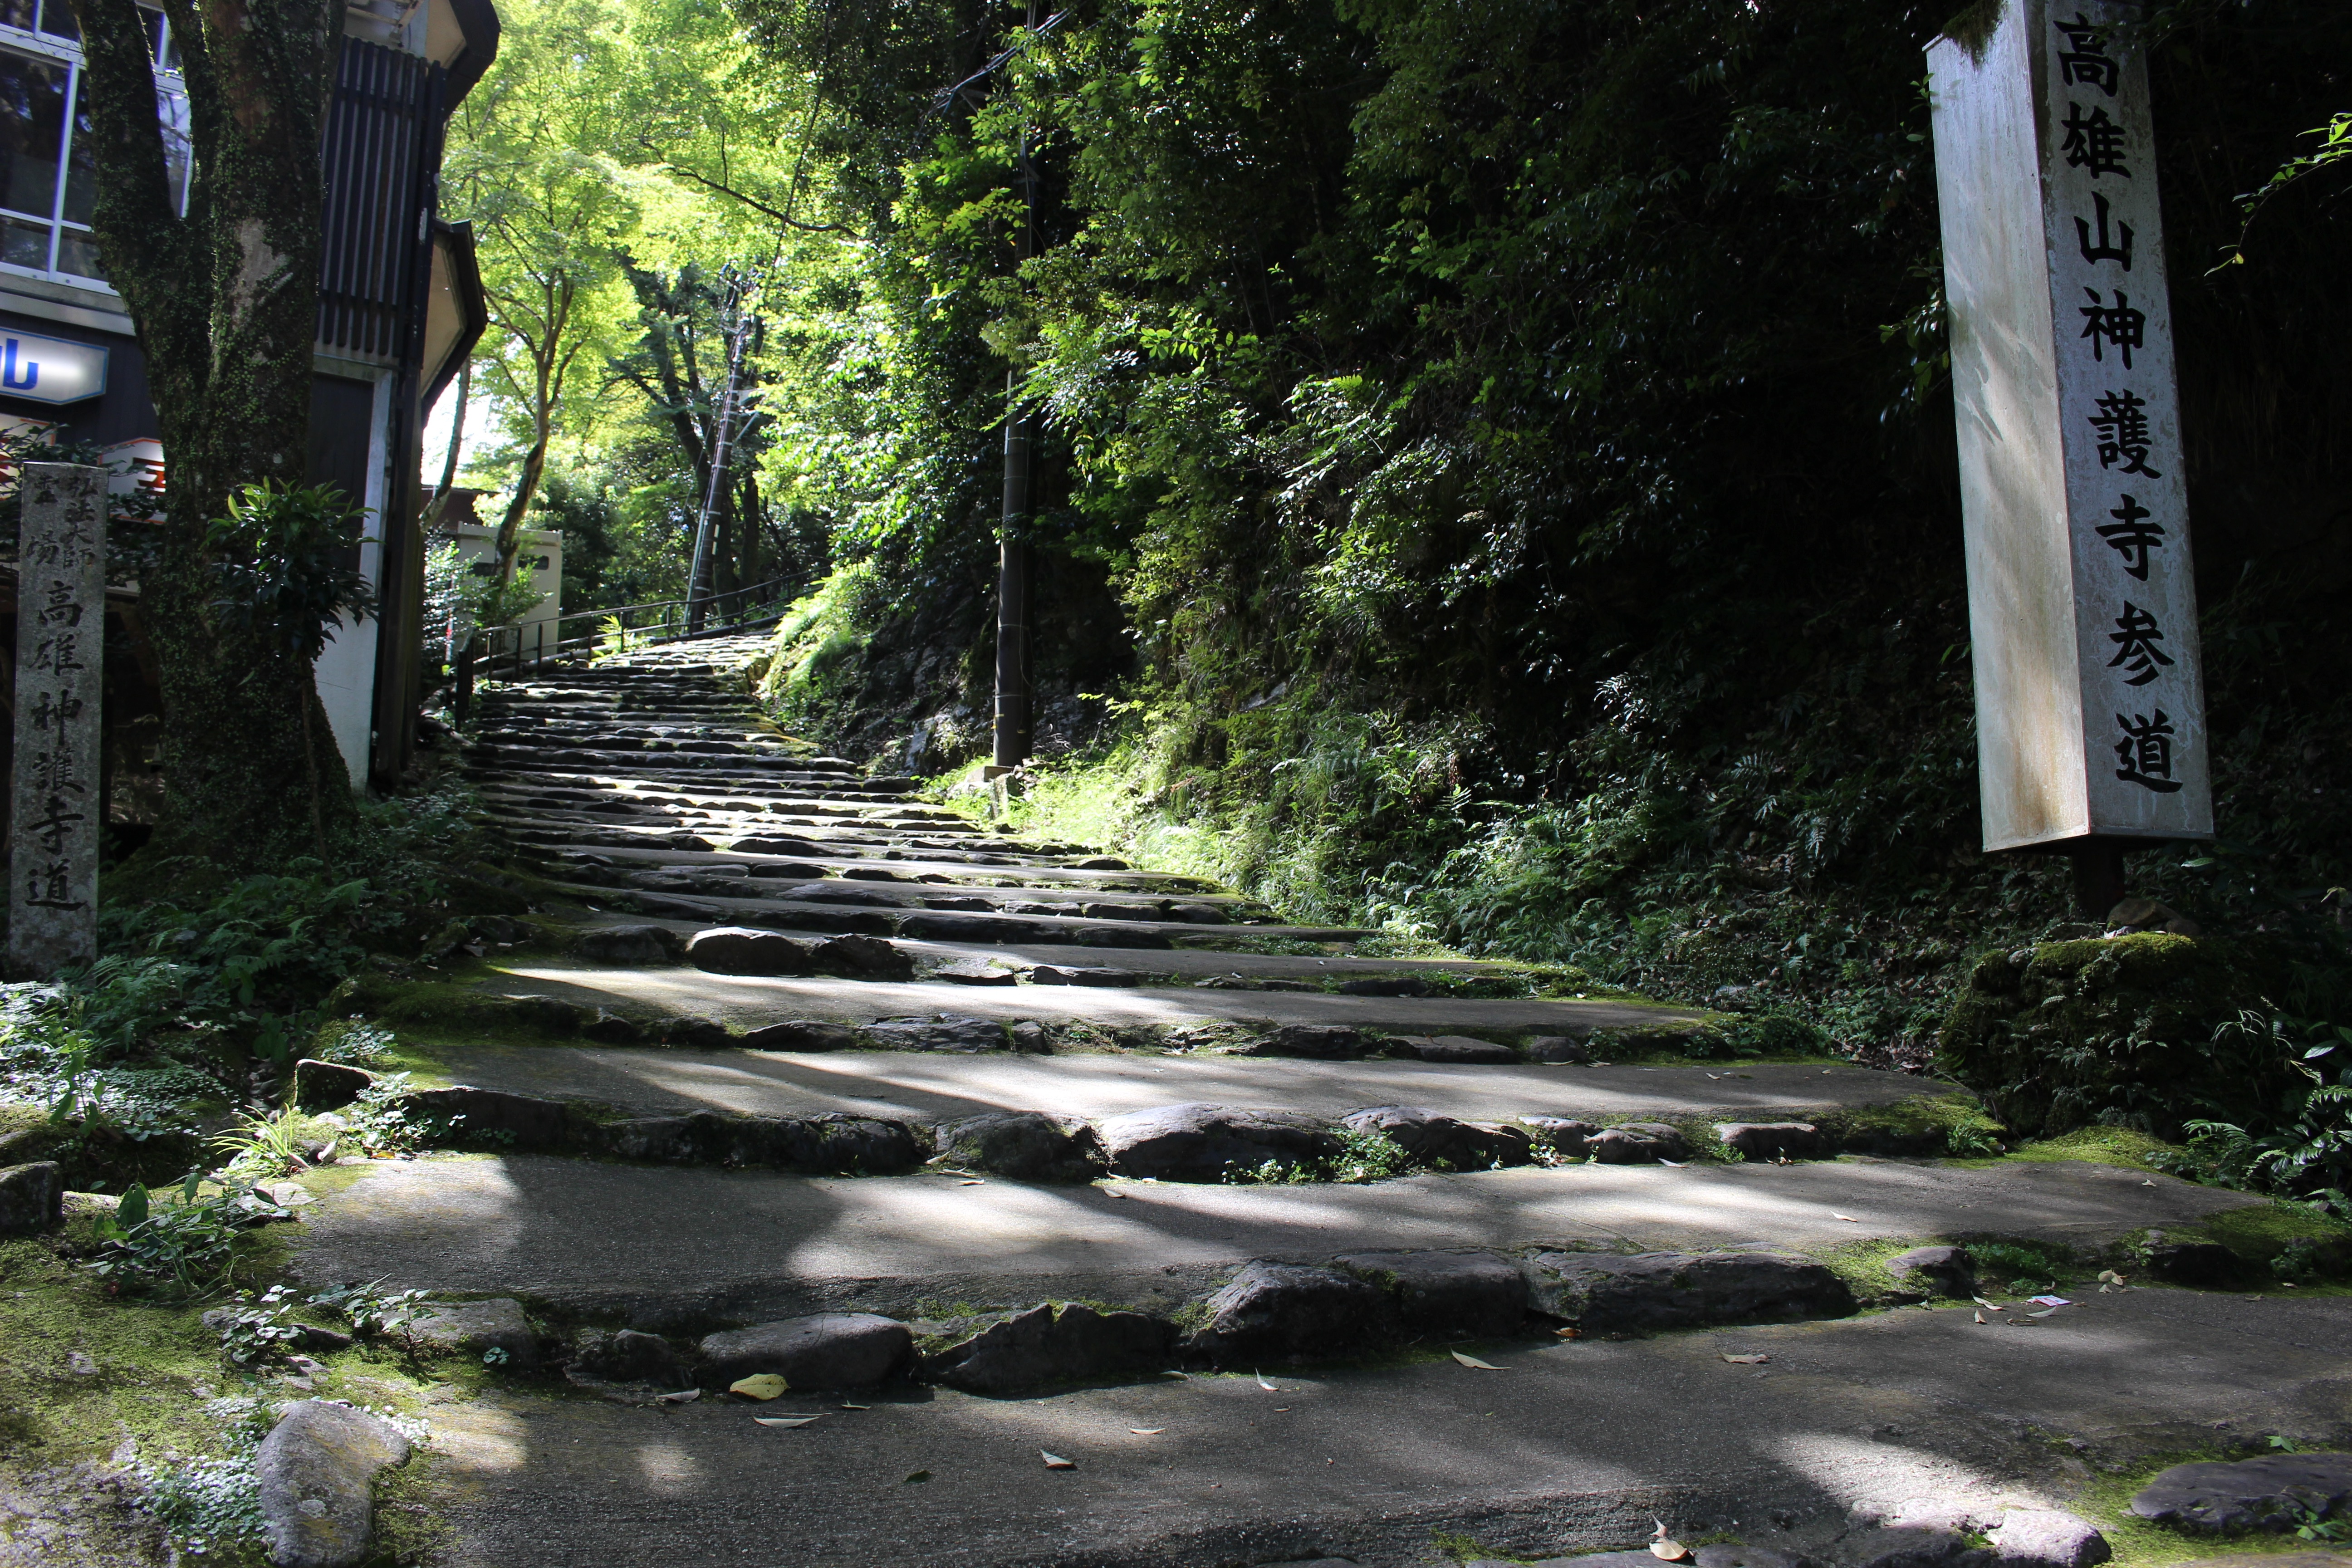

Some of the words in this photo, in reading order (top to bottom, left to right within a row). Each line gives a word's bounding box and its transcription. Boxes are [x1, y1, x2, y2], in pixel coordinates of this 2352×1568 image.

[2053, 11, 2184, 794] 高雄山神護寺参道
[25, 580, 89, 912] 高雄神護寺道
